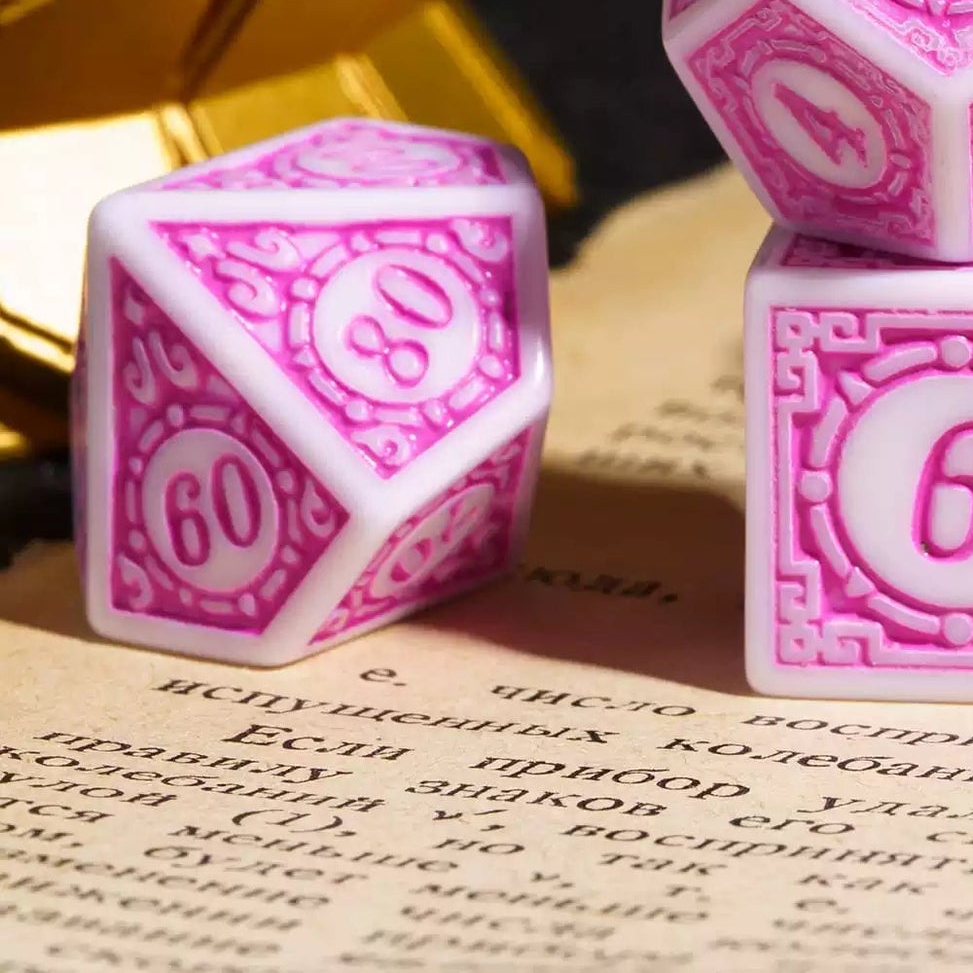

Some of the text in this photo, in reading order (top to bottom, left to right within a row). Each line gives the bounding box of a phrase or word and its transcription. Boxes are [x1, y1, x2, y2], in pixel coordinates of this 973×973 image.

[771, 82, 870, 170] 4
[343, 263, 454, 388] 80
[163, 454, 262, 569] 60
[152, 678, 621, 745] испущенных
[490, 684, 697, 717] число
[33, 730, 354, 784] правилу
[404, 779, 669, 818] знаков
[728, 815, 856, 836] его
[220, 723, 415, 761] Если
[468, 756, 751, 800] прибор
[167, 824, 459, 871] меньше
[431, 838, 526, 856] но
